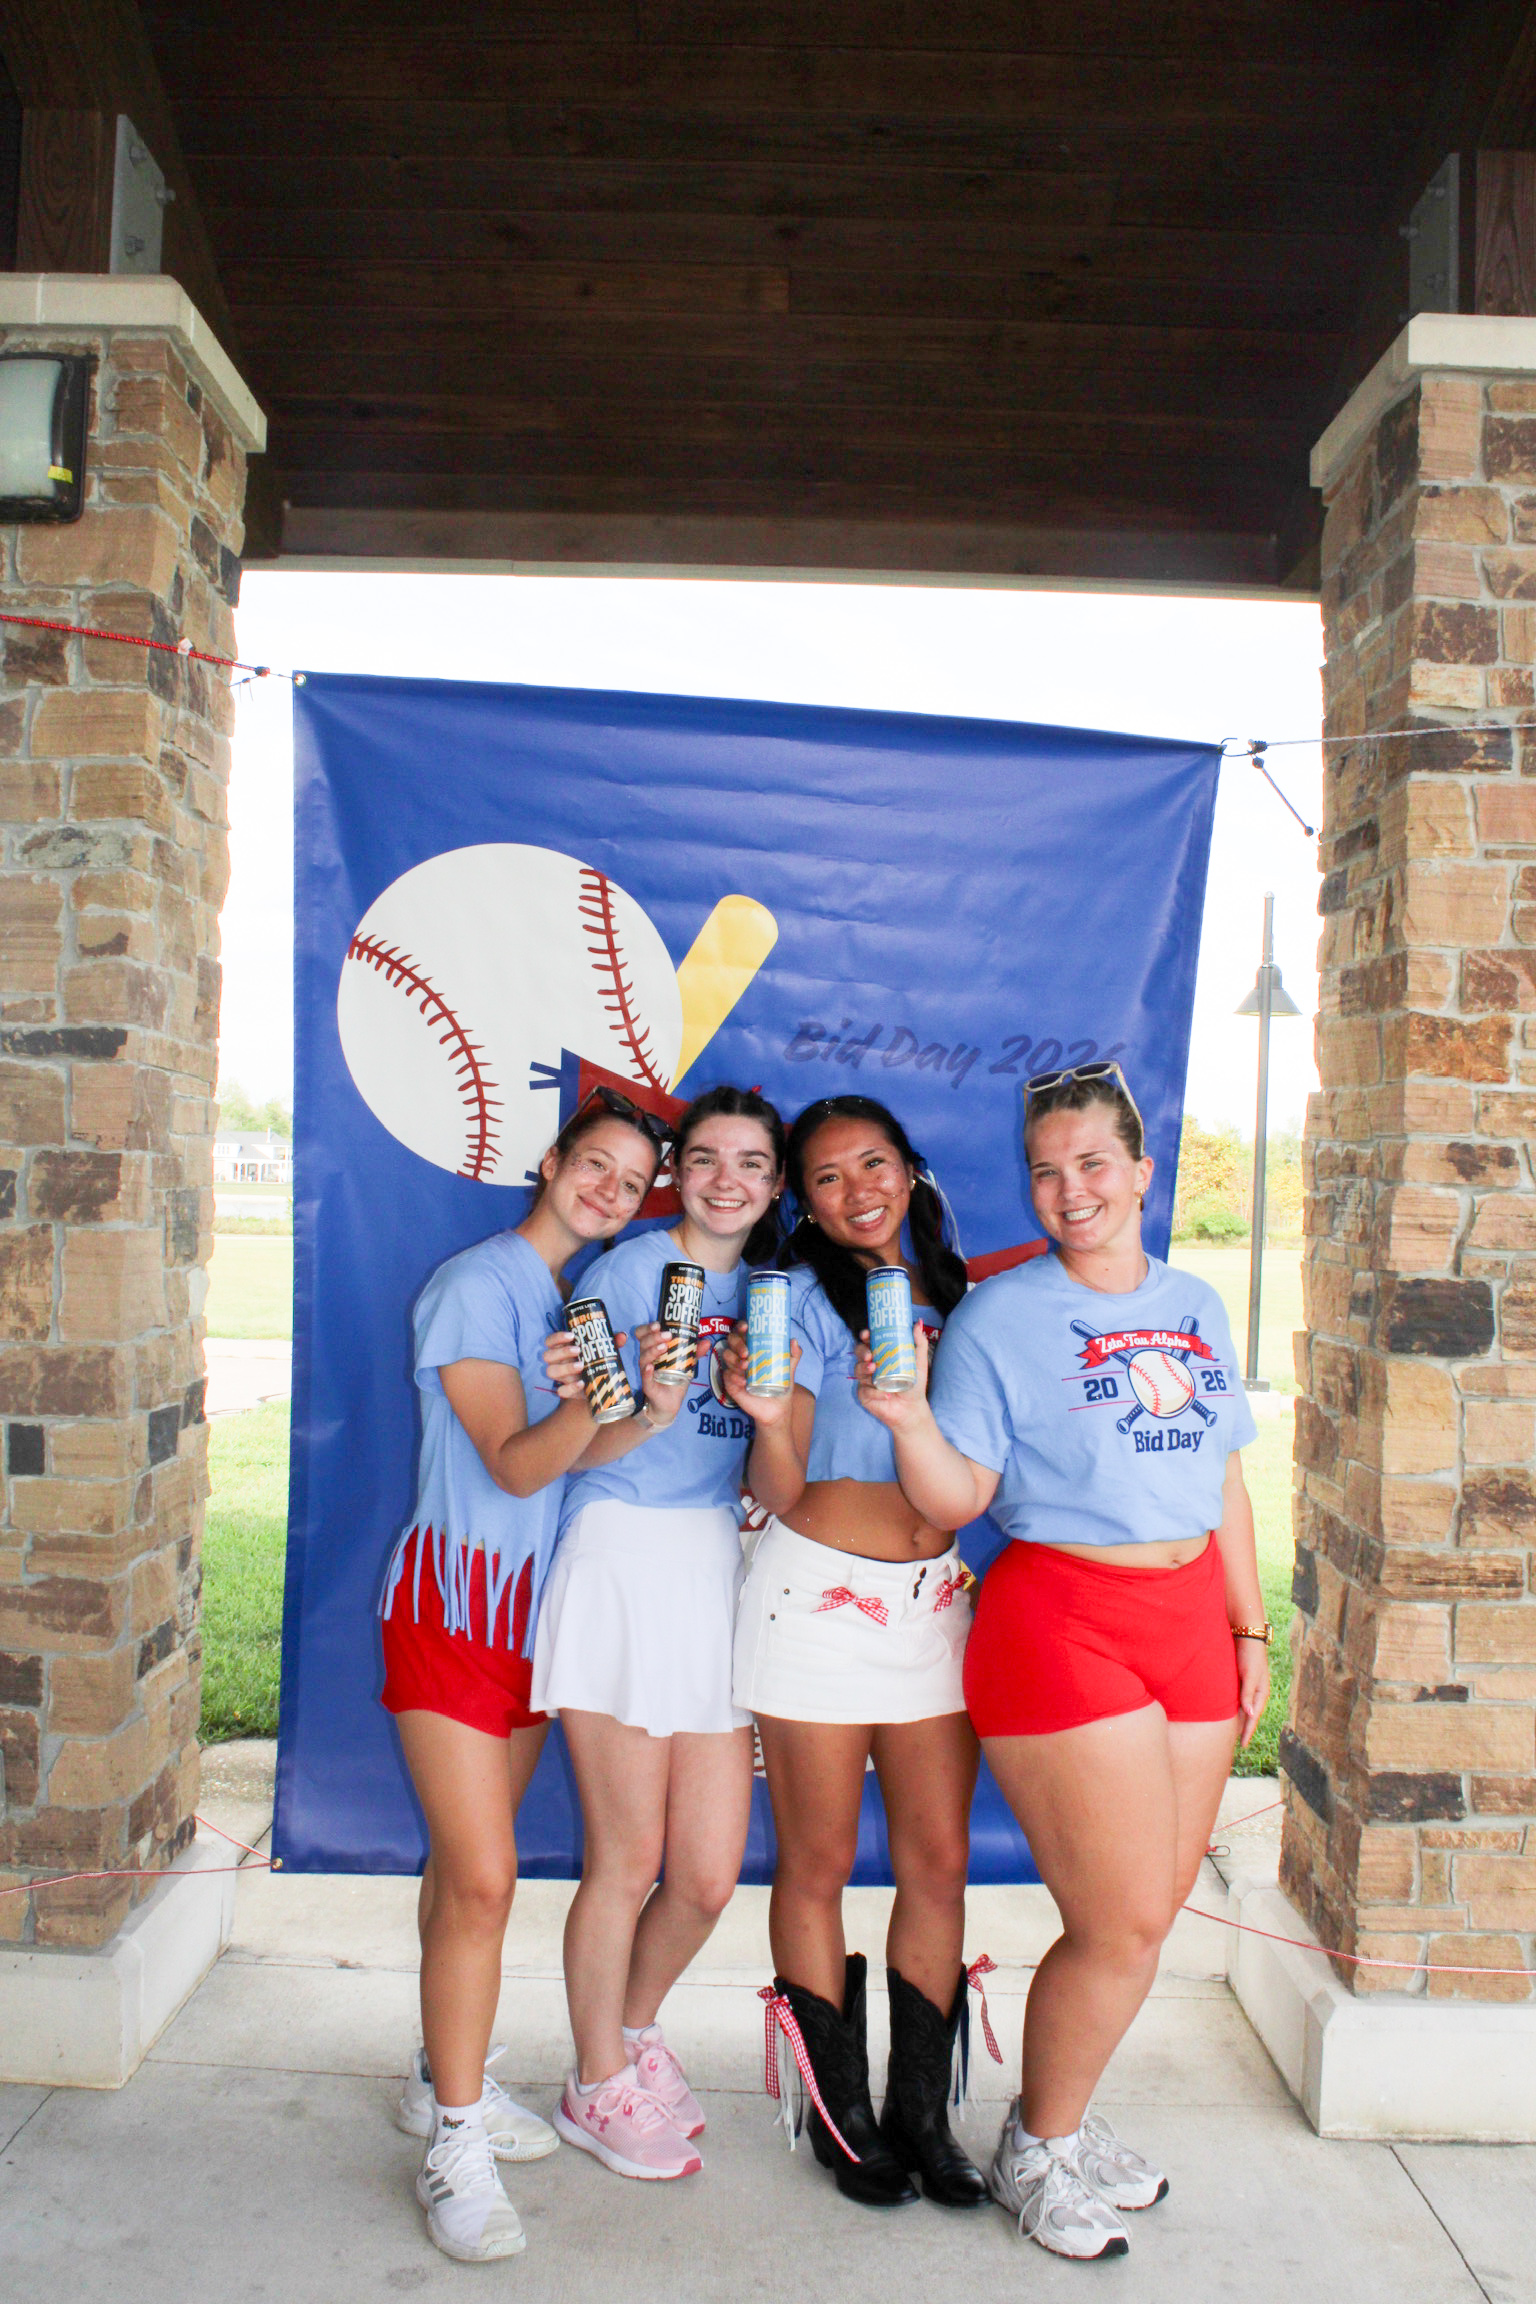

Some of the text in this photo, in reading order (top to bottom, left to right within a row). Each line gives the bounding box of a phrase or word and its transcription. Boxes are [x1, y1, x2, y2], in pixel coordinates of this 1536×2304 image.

[784, 1017, 884, 1070] Bid
[882, 1026, 983, 1090] Day
[668, 1283, 703, 1308] SPORT
[750, 1295, 787, 1315] SPORT
[869, 1289, 906, 1311] SPORT
[698, 1318, 731, 1335] ta Tau
[748, 1314, 787, 1336] COFFEE
[870, 1307, 909, 1331] COFFEE
[571, 1318, 610, 1346] SPORT
[1095, 1332, 1191, 1354] Zeta Tau Alpha
[1083, 1369, 1227, 1402] 20 26
[697, 1412, 755, 1439] Bid Da
[1132, 1428, 1204, 1453] Bid Day
